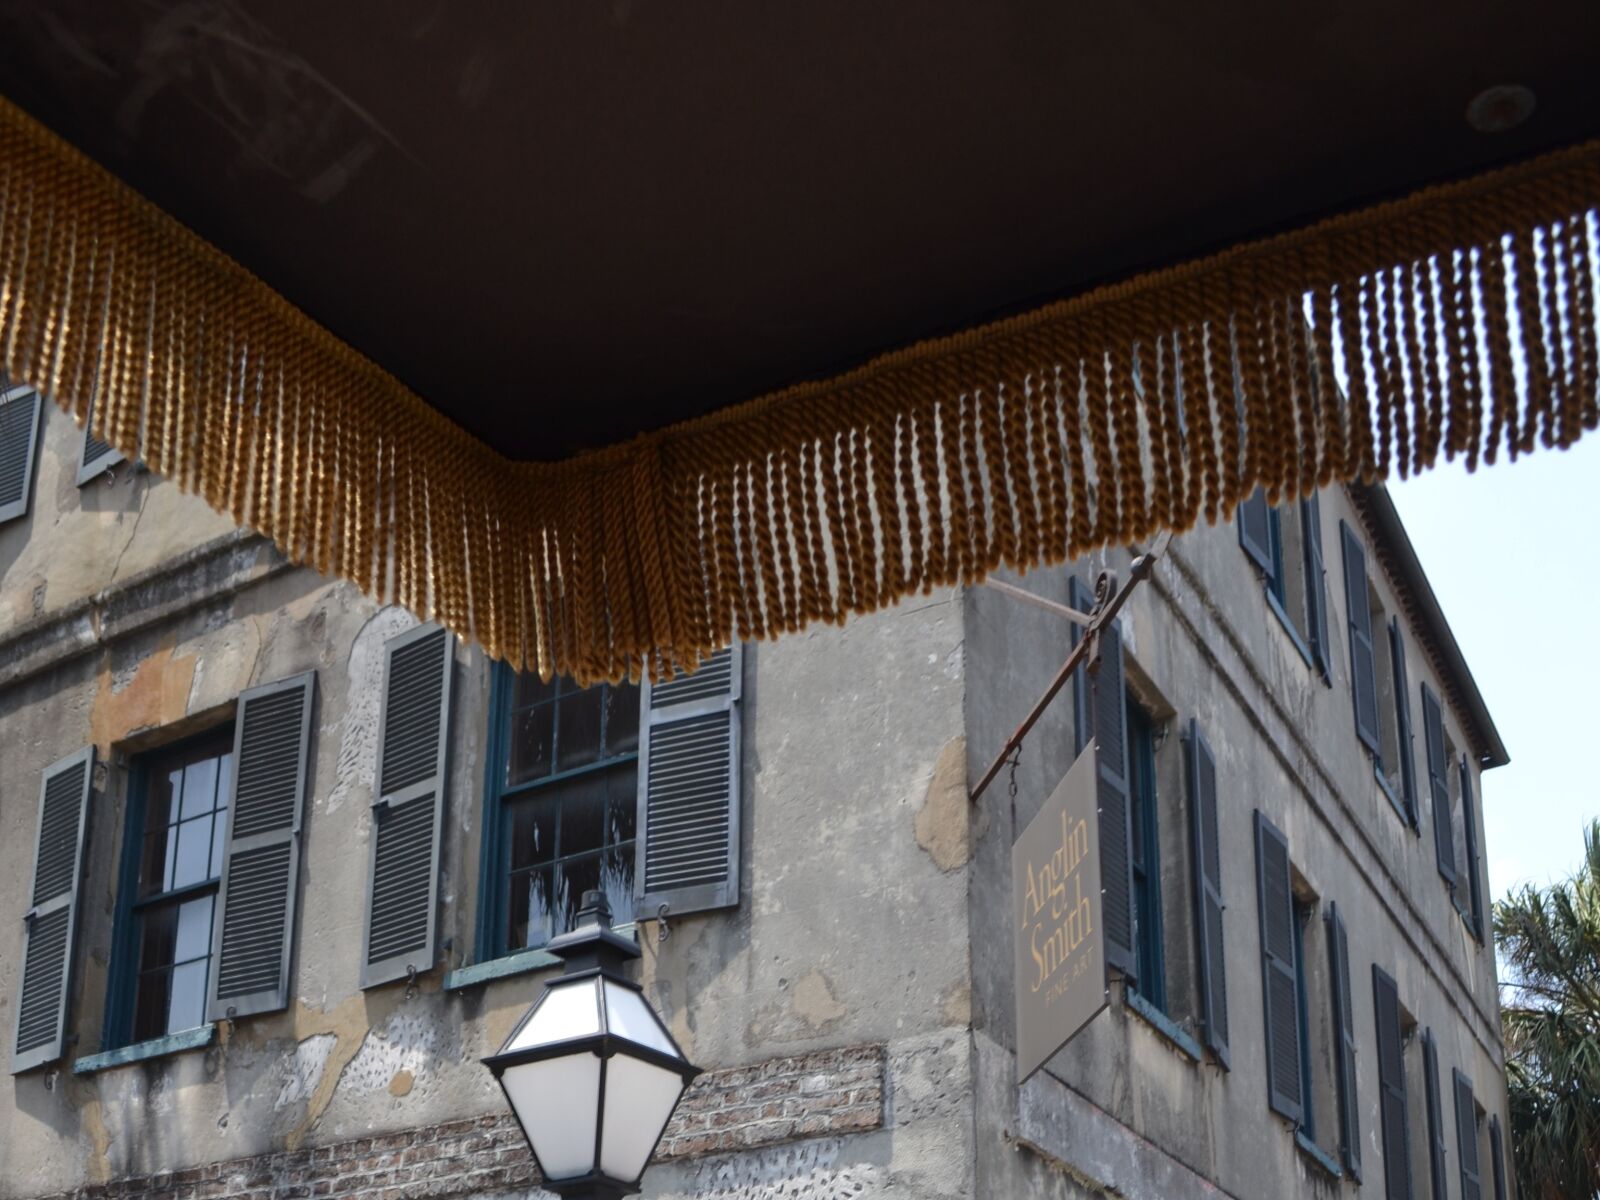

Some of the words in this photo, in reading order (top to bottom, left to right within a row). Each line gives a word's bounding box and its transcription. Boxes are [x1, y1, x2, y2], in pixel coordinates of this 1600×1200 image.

[1022, 808, 1089, 929] Anglin
[1031, 874, 1094, 993] Smith
[1045, 971, 1070, 1006] FINE
[1072, 946, 1095, 984] ART
